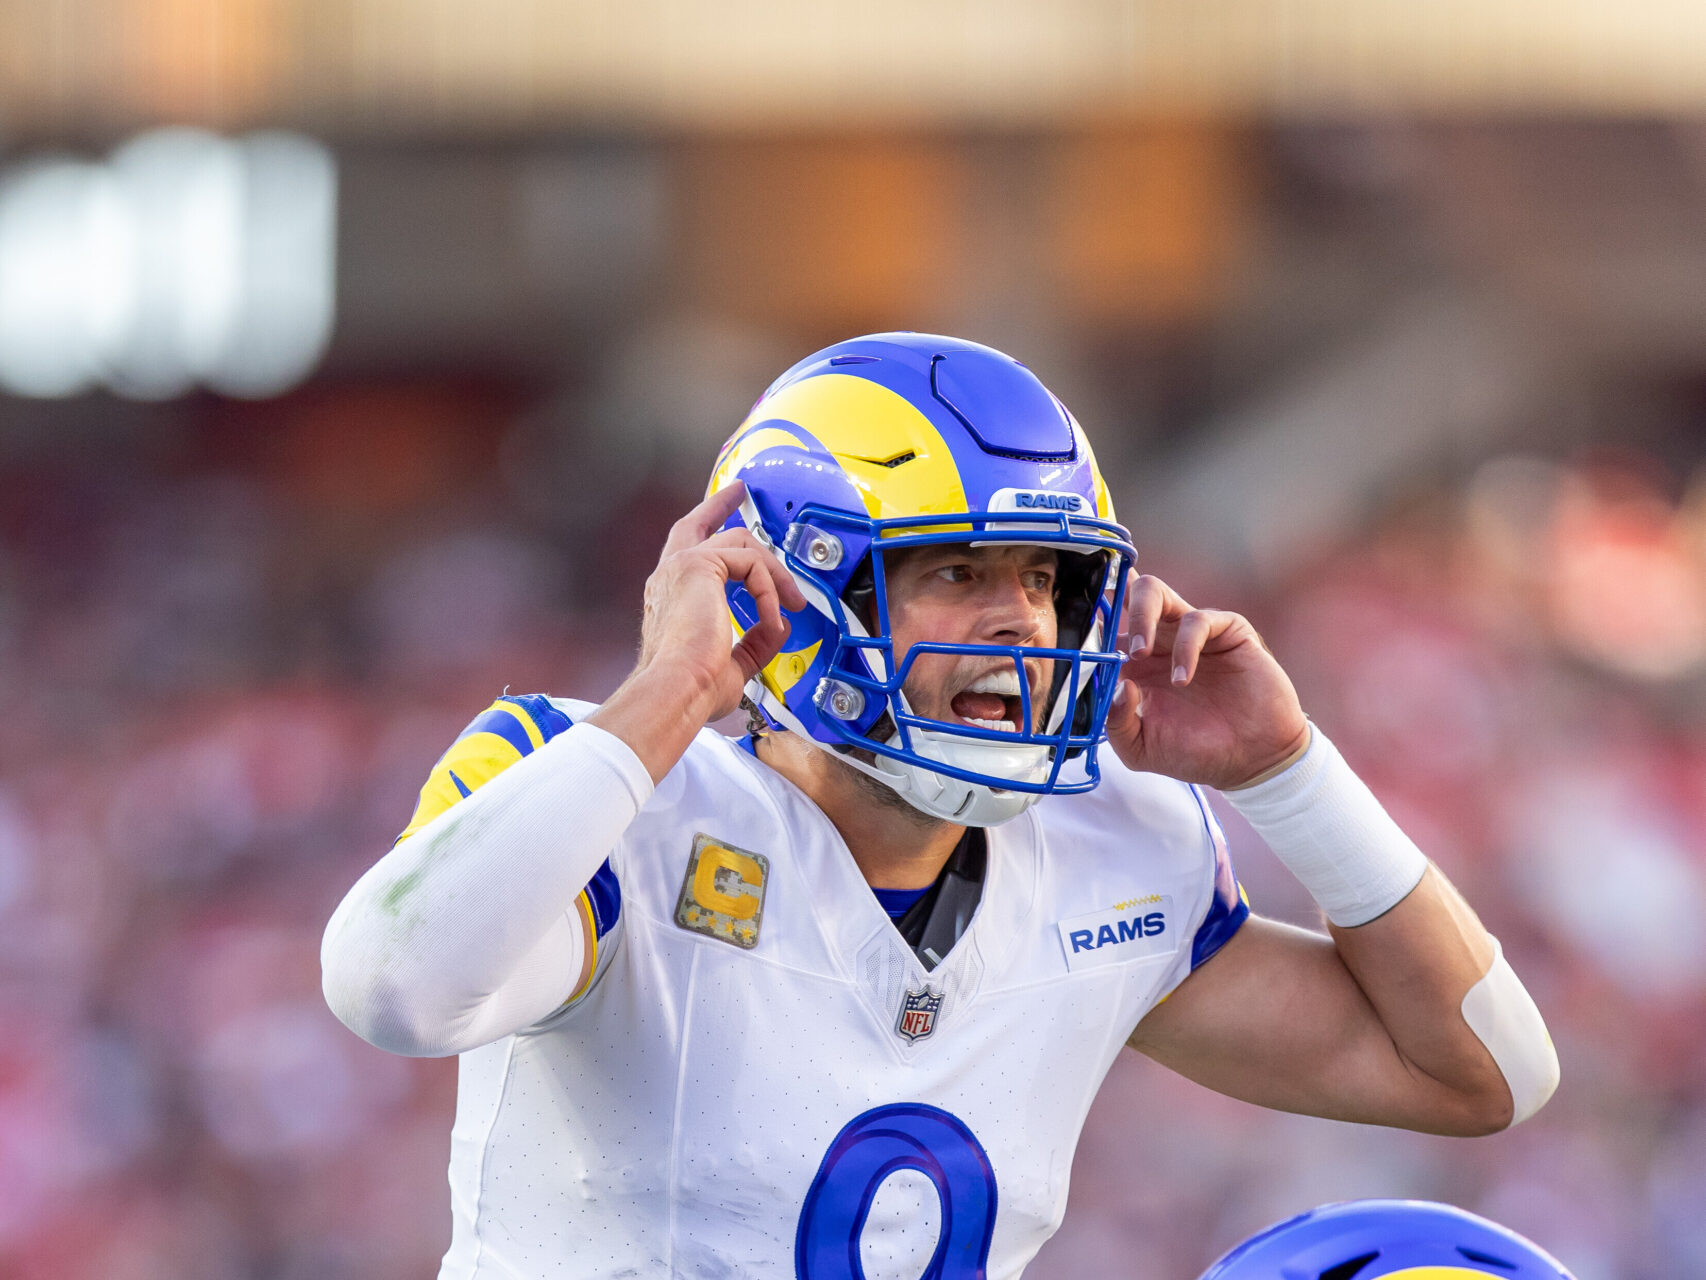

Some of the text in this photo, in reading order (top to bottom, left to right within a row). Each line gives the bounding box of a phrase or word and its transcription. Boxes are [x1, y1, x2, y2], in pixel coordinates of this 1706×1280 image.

[1015, 493, 1081, 511] RAMS
[693, 845, 763, 920] C
[1069, 912, 1166, 953] RAMS
[902, 1012, 930, 1034] NFL
